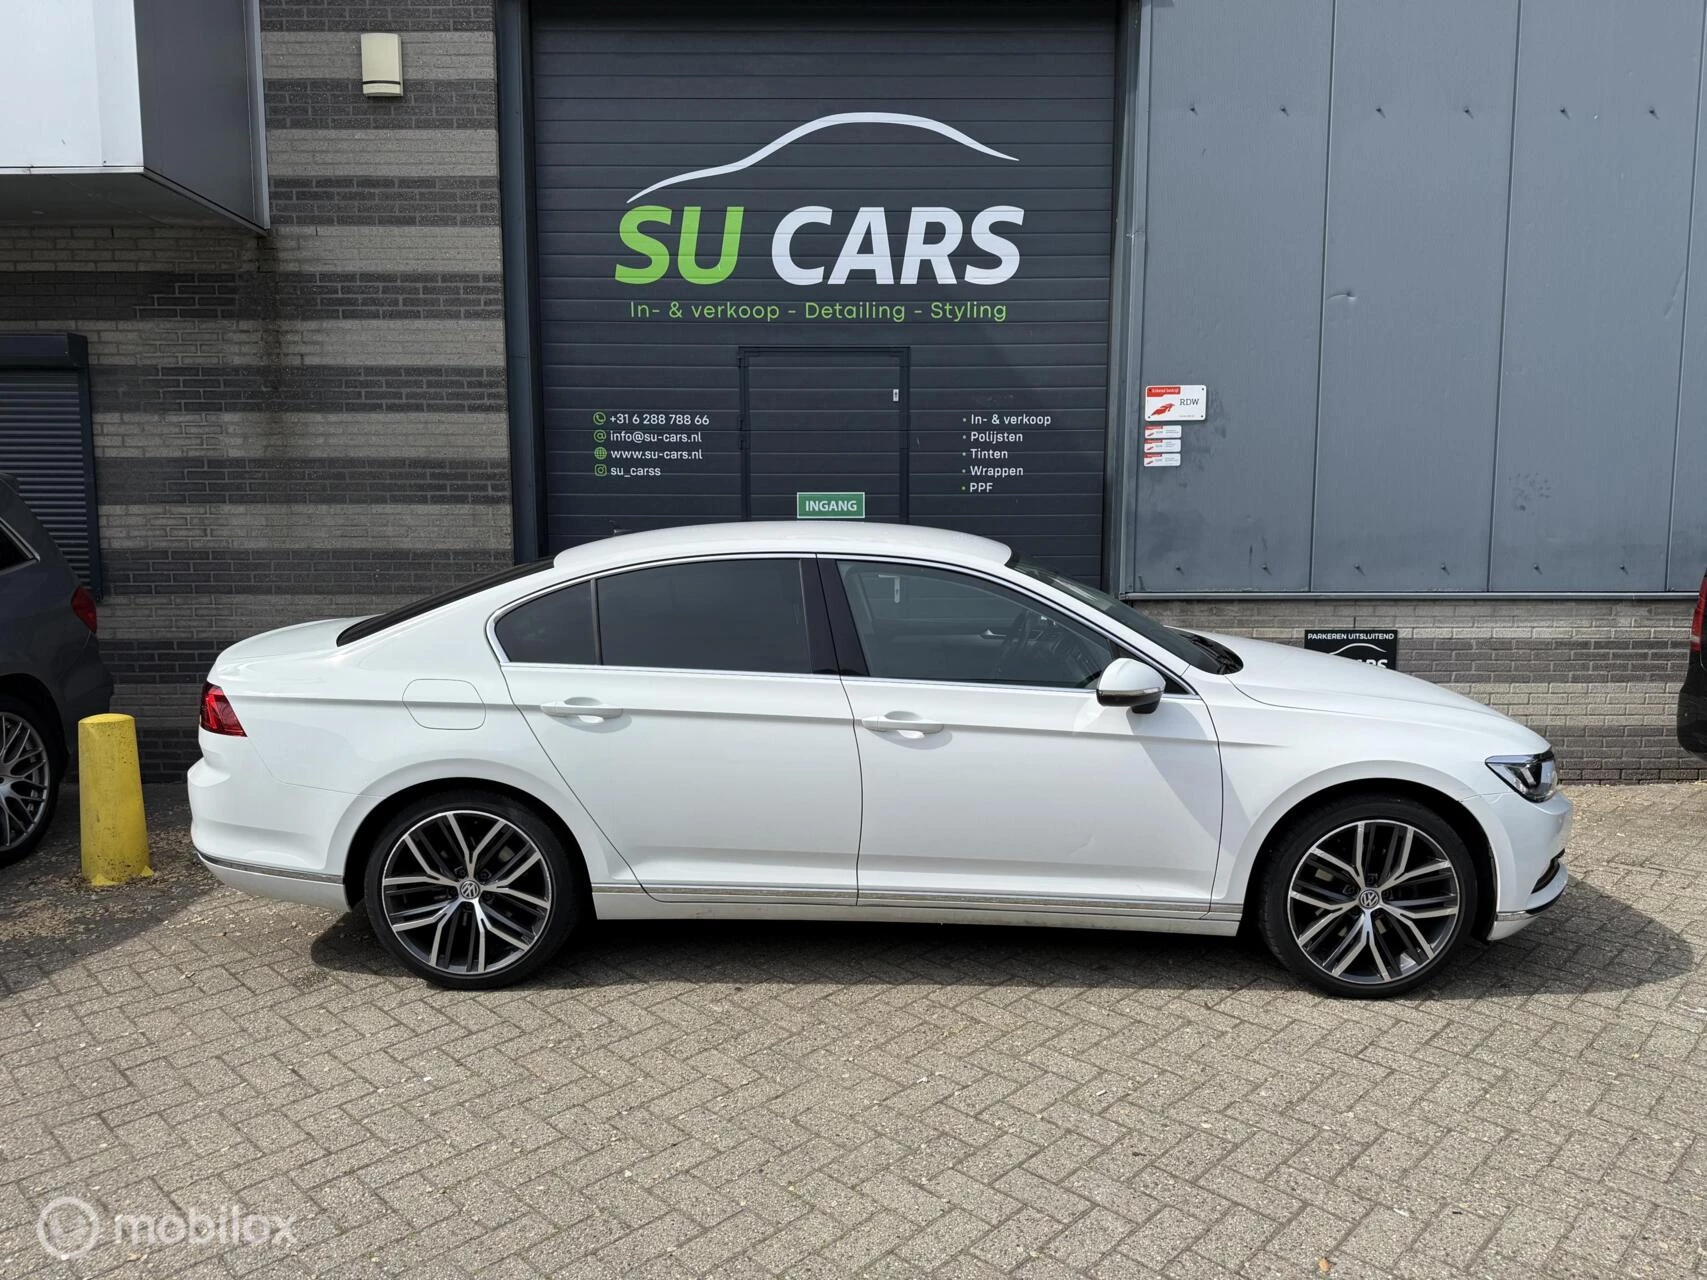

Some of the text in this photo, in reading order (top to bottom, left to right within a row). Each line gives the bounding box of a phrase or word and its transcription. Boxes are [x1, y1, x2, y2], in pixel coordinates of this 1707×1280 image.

[614, 205, 1025, 286] SU CARS
[630, 302, 660, 318] In-
[668, 301, 683, 318] &
[691, 301, 780, 322] verkoop
[805, 302, 906, 322] Detailing
[930, 302, 1007, 322] Styling
[610, 414, 710, 425] +31 6 288 788 66
[971, 413, 1052, 427] In- & verkoop
[610, 430, 702, 443] info@su-cars.nl
[970, 431, 1023, 444] Polijsten
[610, 449, 703, 460] www.su-cars.nl
[970, 448, 1008, 459] Tinten
[610, 466, 662, 478] su_carss
[969, 465, 1024, 478] Wrappen
[969, 482, 994, 493] PPF
[805, 500, 857, 512] INGANG
